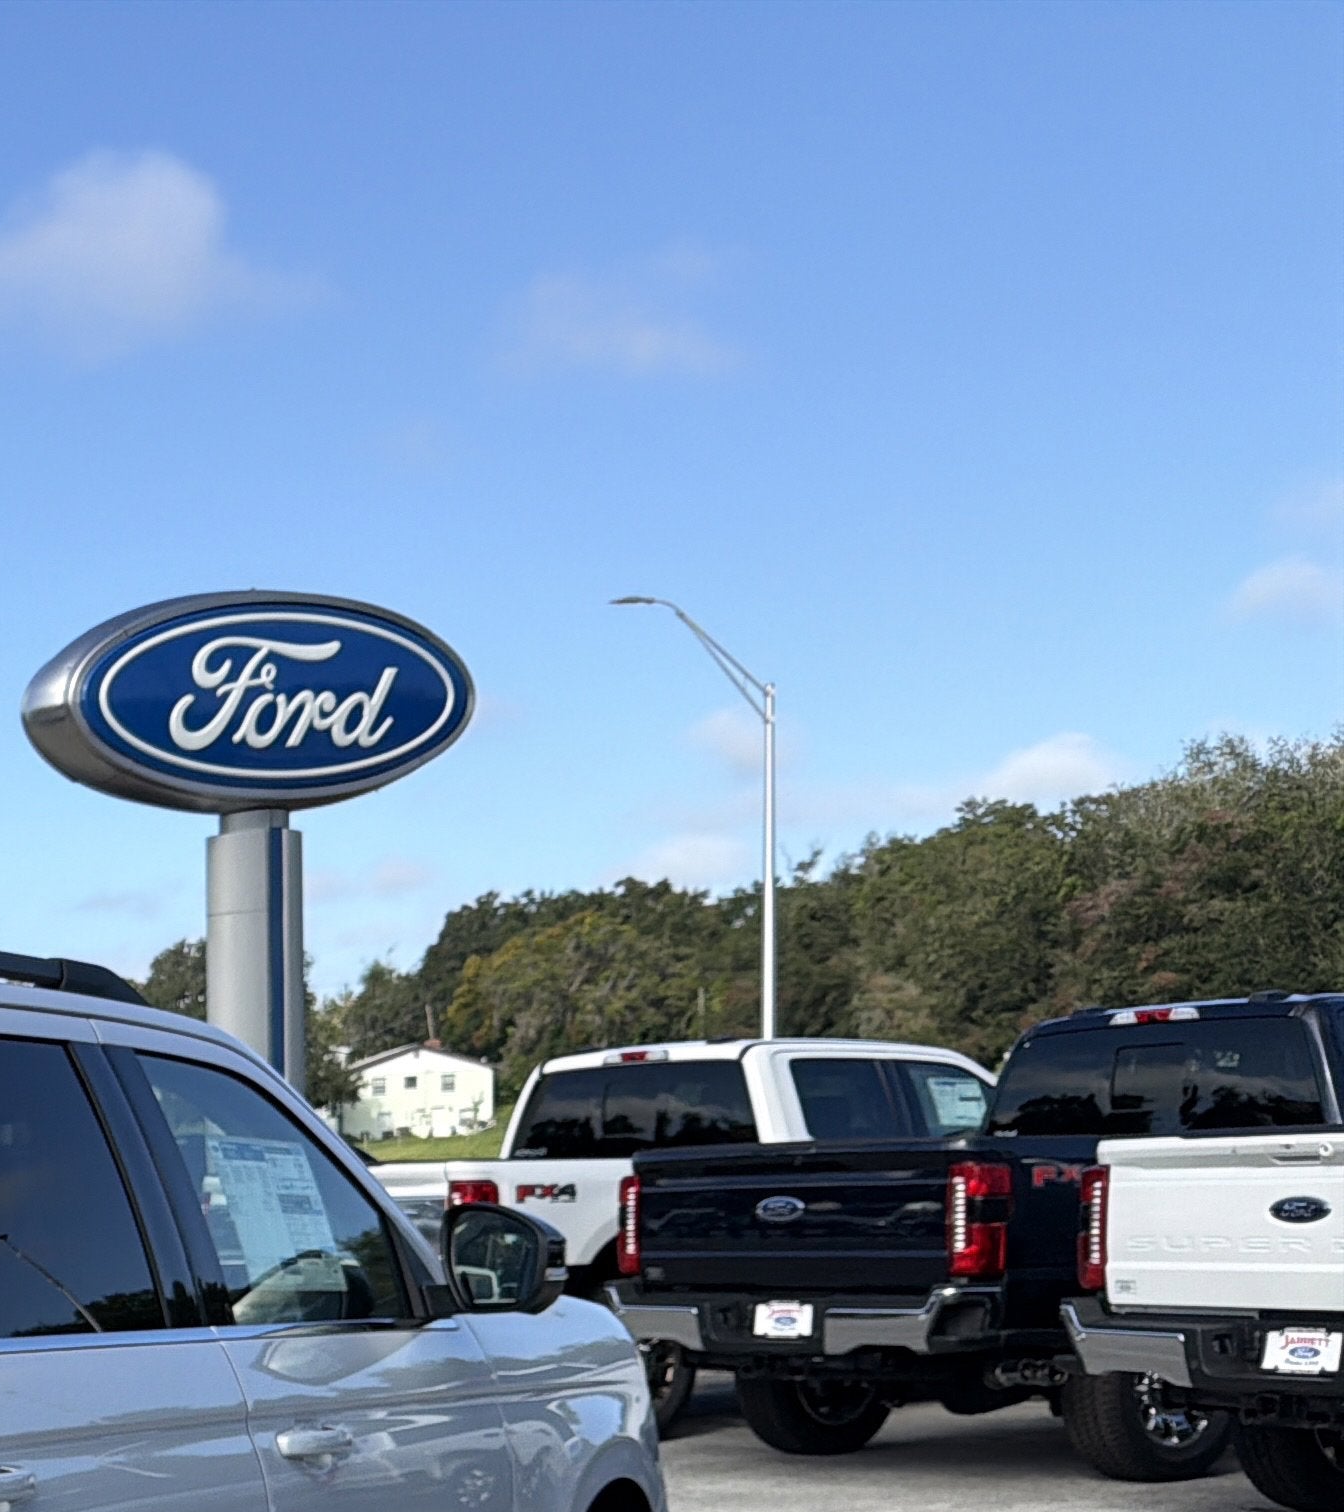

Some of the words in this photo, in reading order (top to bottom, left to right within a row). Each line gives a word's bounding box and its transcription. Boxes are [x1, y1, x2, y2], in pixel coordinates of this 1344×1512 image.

[168, 636, 399, 751] Ford
[1032, 1165, 1082, 1188] FX
[515, 1184, 576, 1204] FX4
[1126, 1236, 1312, 1253] SUPER
